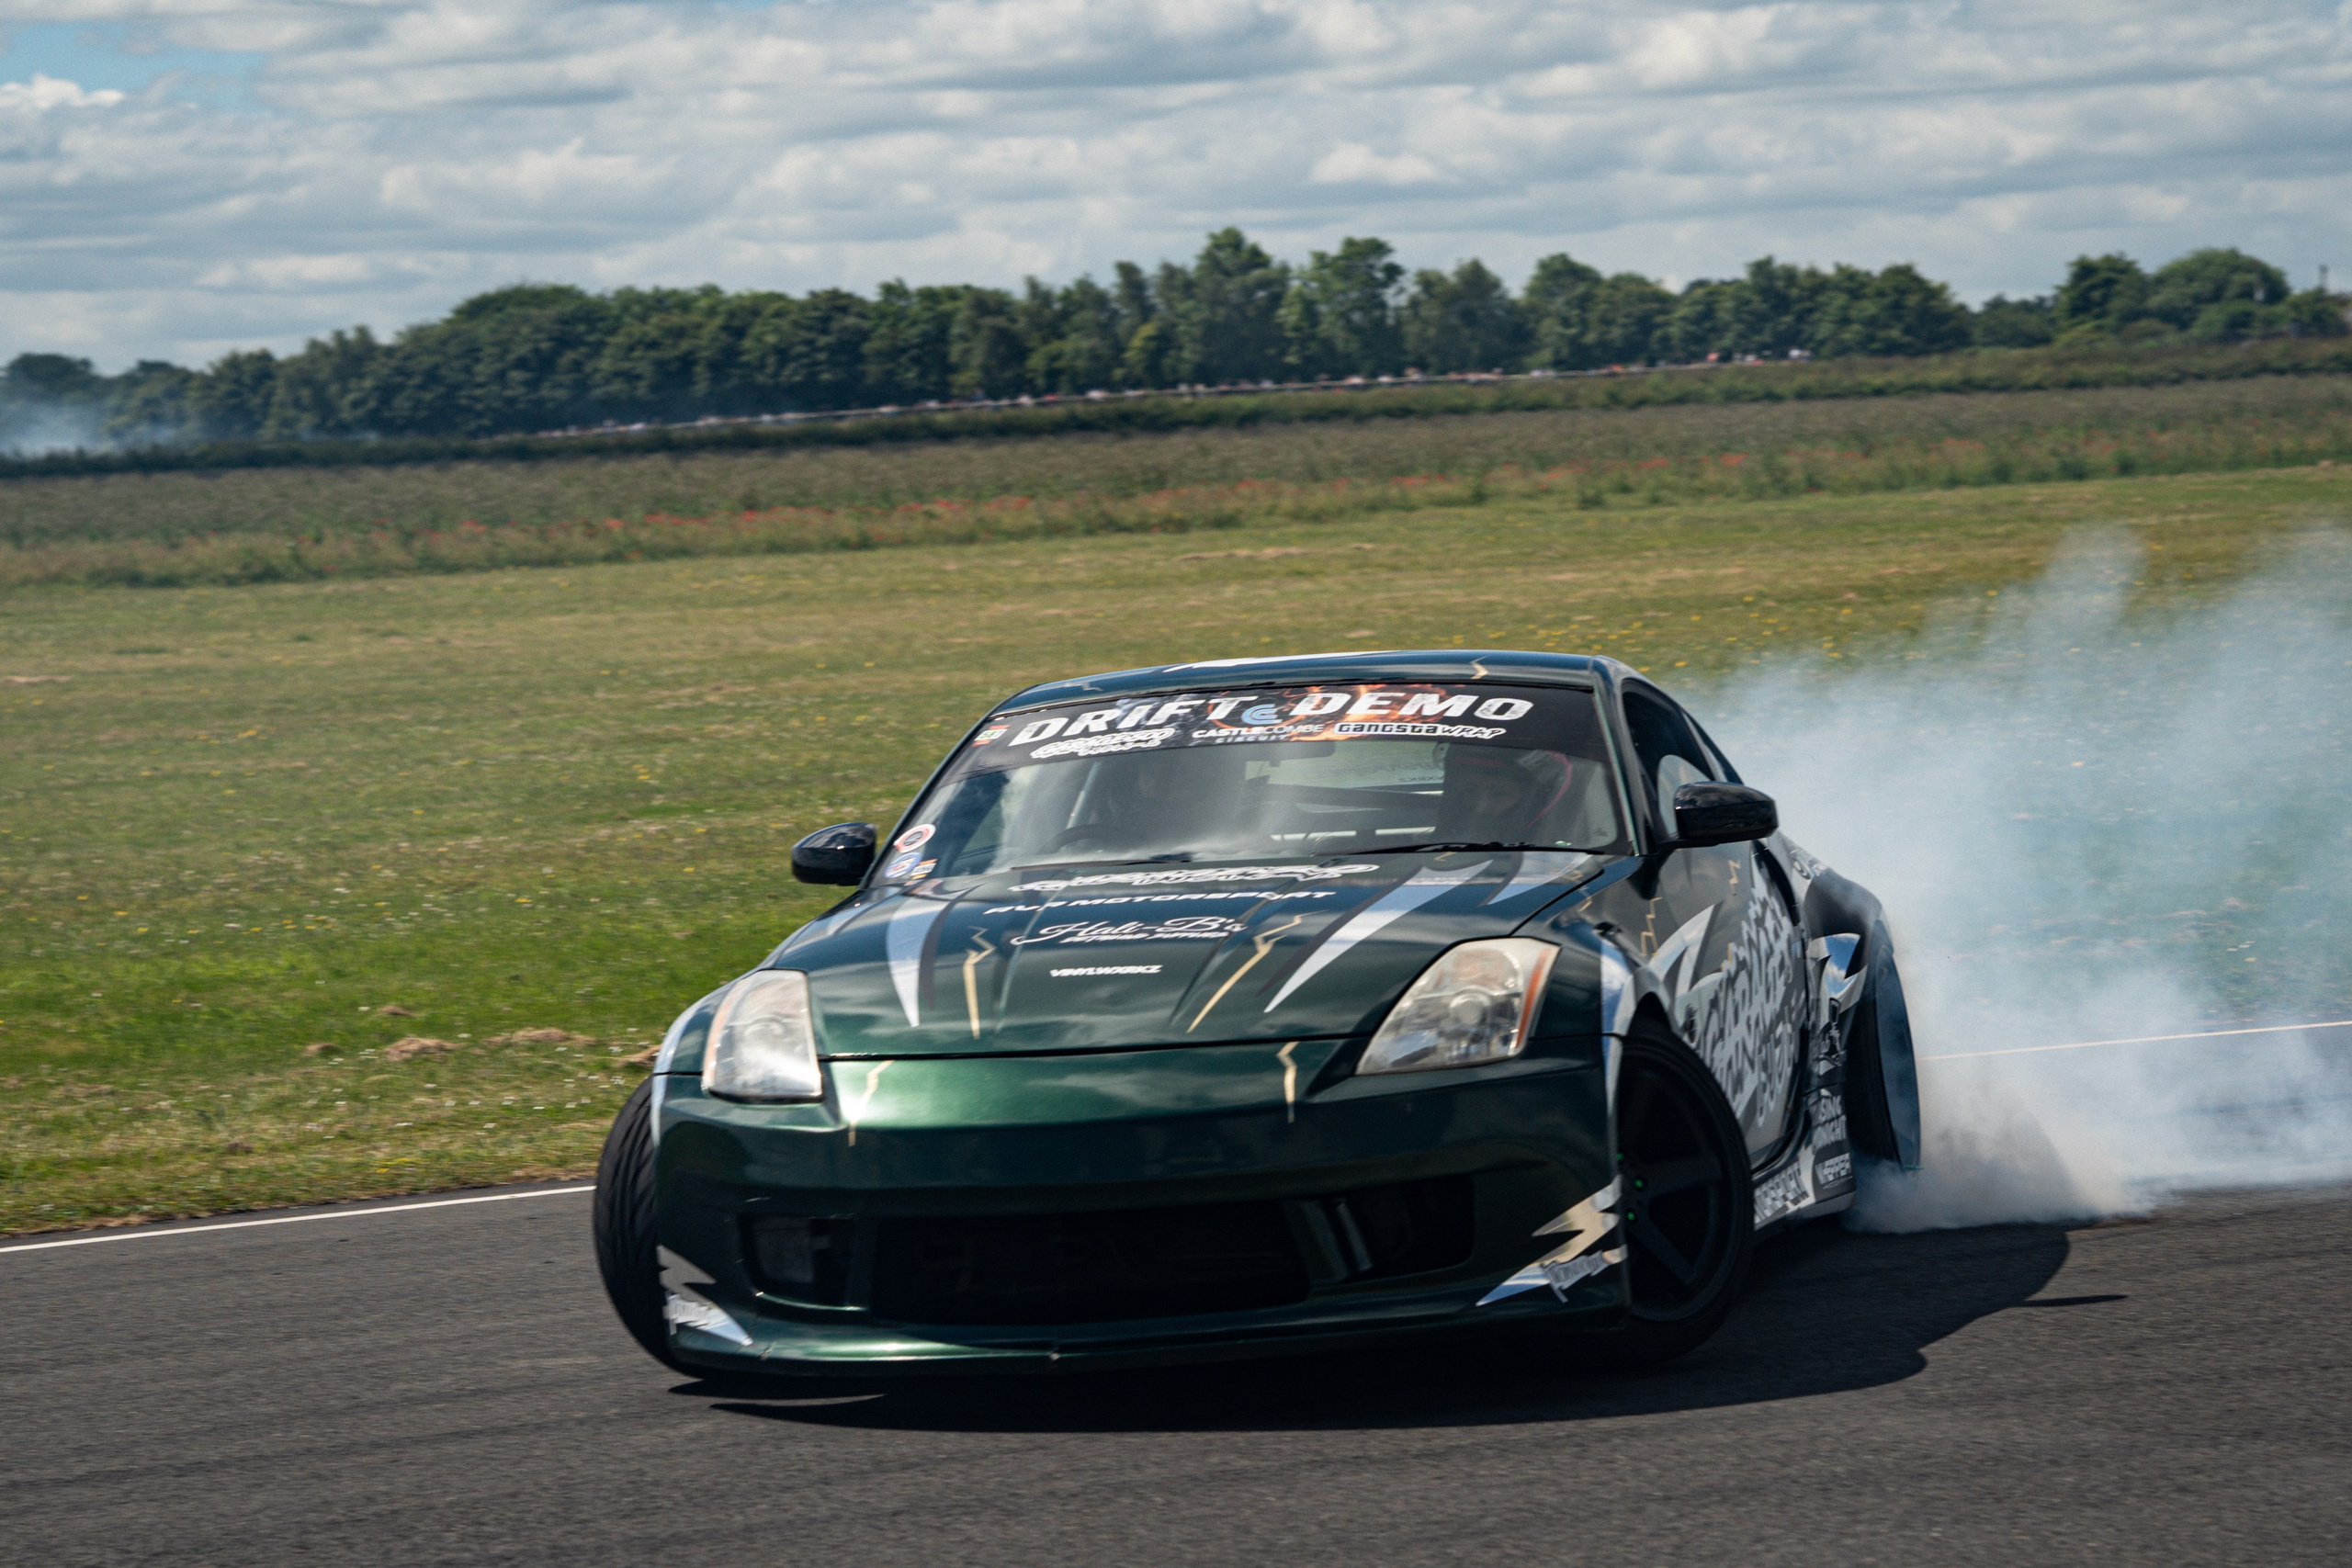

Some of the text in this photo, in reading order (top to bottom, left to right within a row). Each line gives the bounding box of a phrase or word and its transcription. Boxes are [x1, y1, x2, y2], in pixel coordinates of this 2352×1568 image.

[1008, 693, 1534, 747] DRIFT DEMO
[1067, 891, 1337, 907] MOTORSPORT
